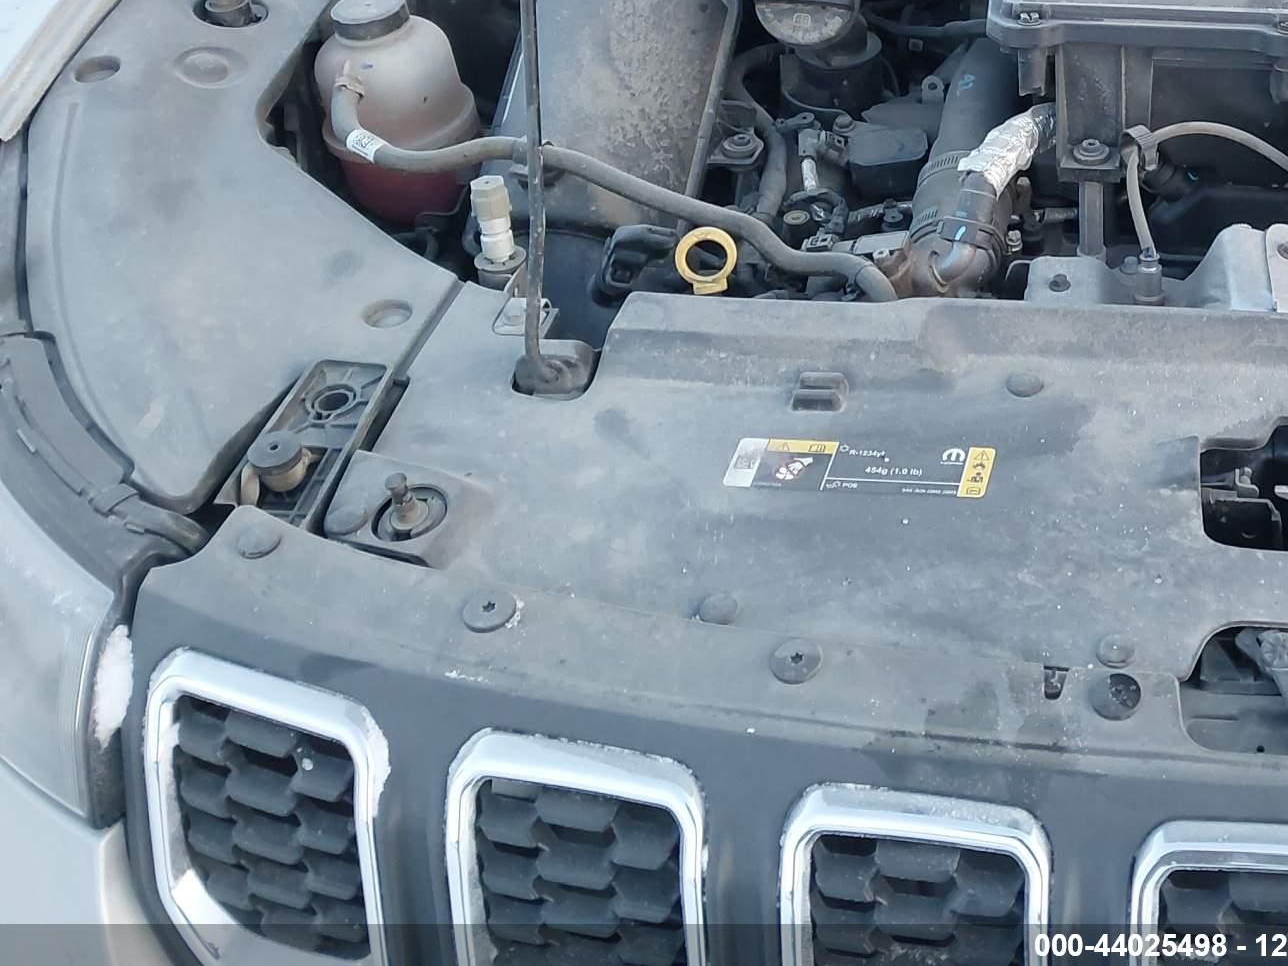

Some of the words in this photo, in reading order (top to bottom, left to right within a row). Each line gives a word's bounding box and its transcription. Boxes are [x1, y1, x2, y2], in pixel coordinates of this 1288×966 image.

[864, 465, 889, 476] 454g
[889, 467, 909, 476] (1.0
[909, 468, 923, 477] lb)
